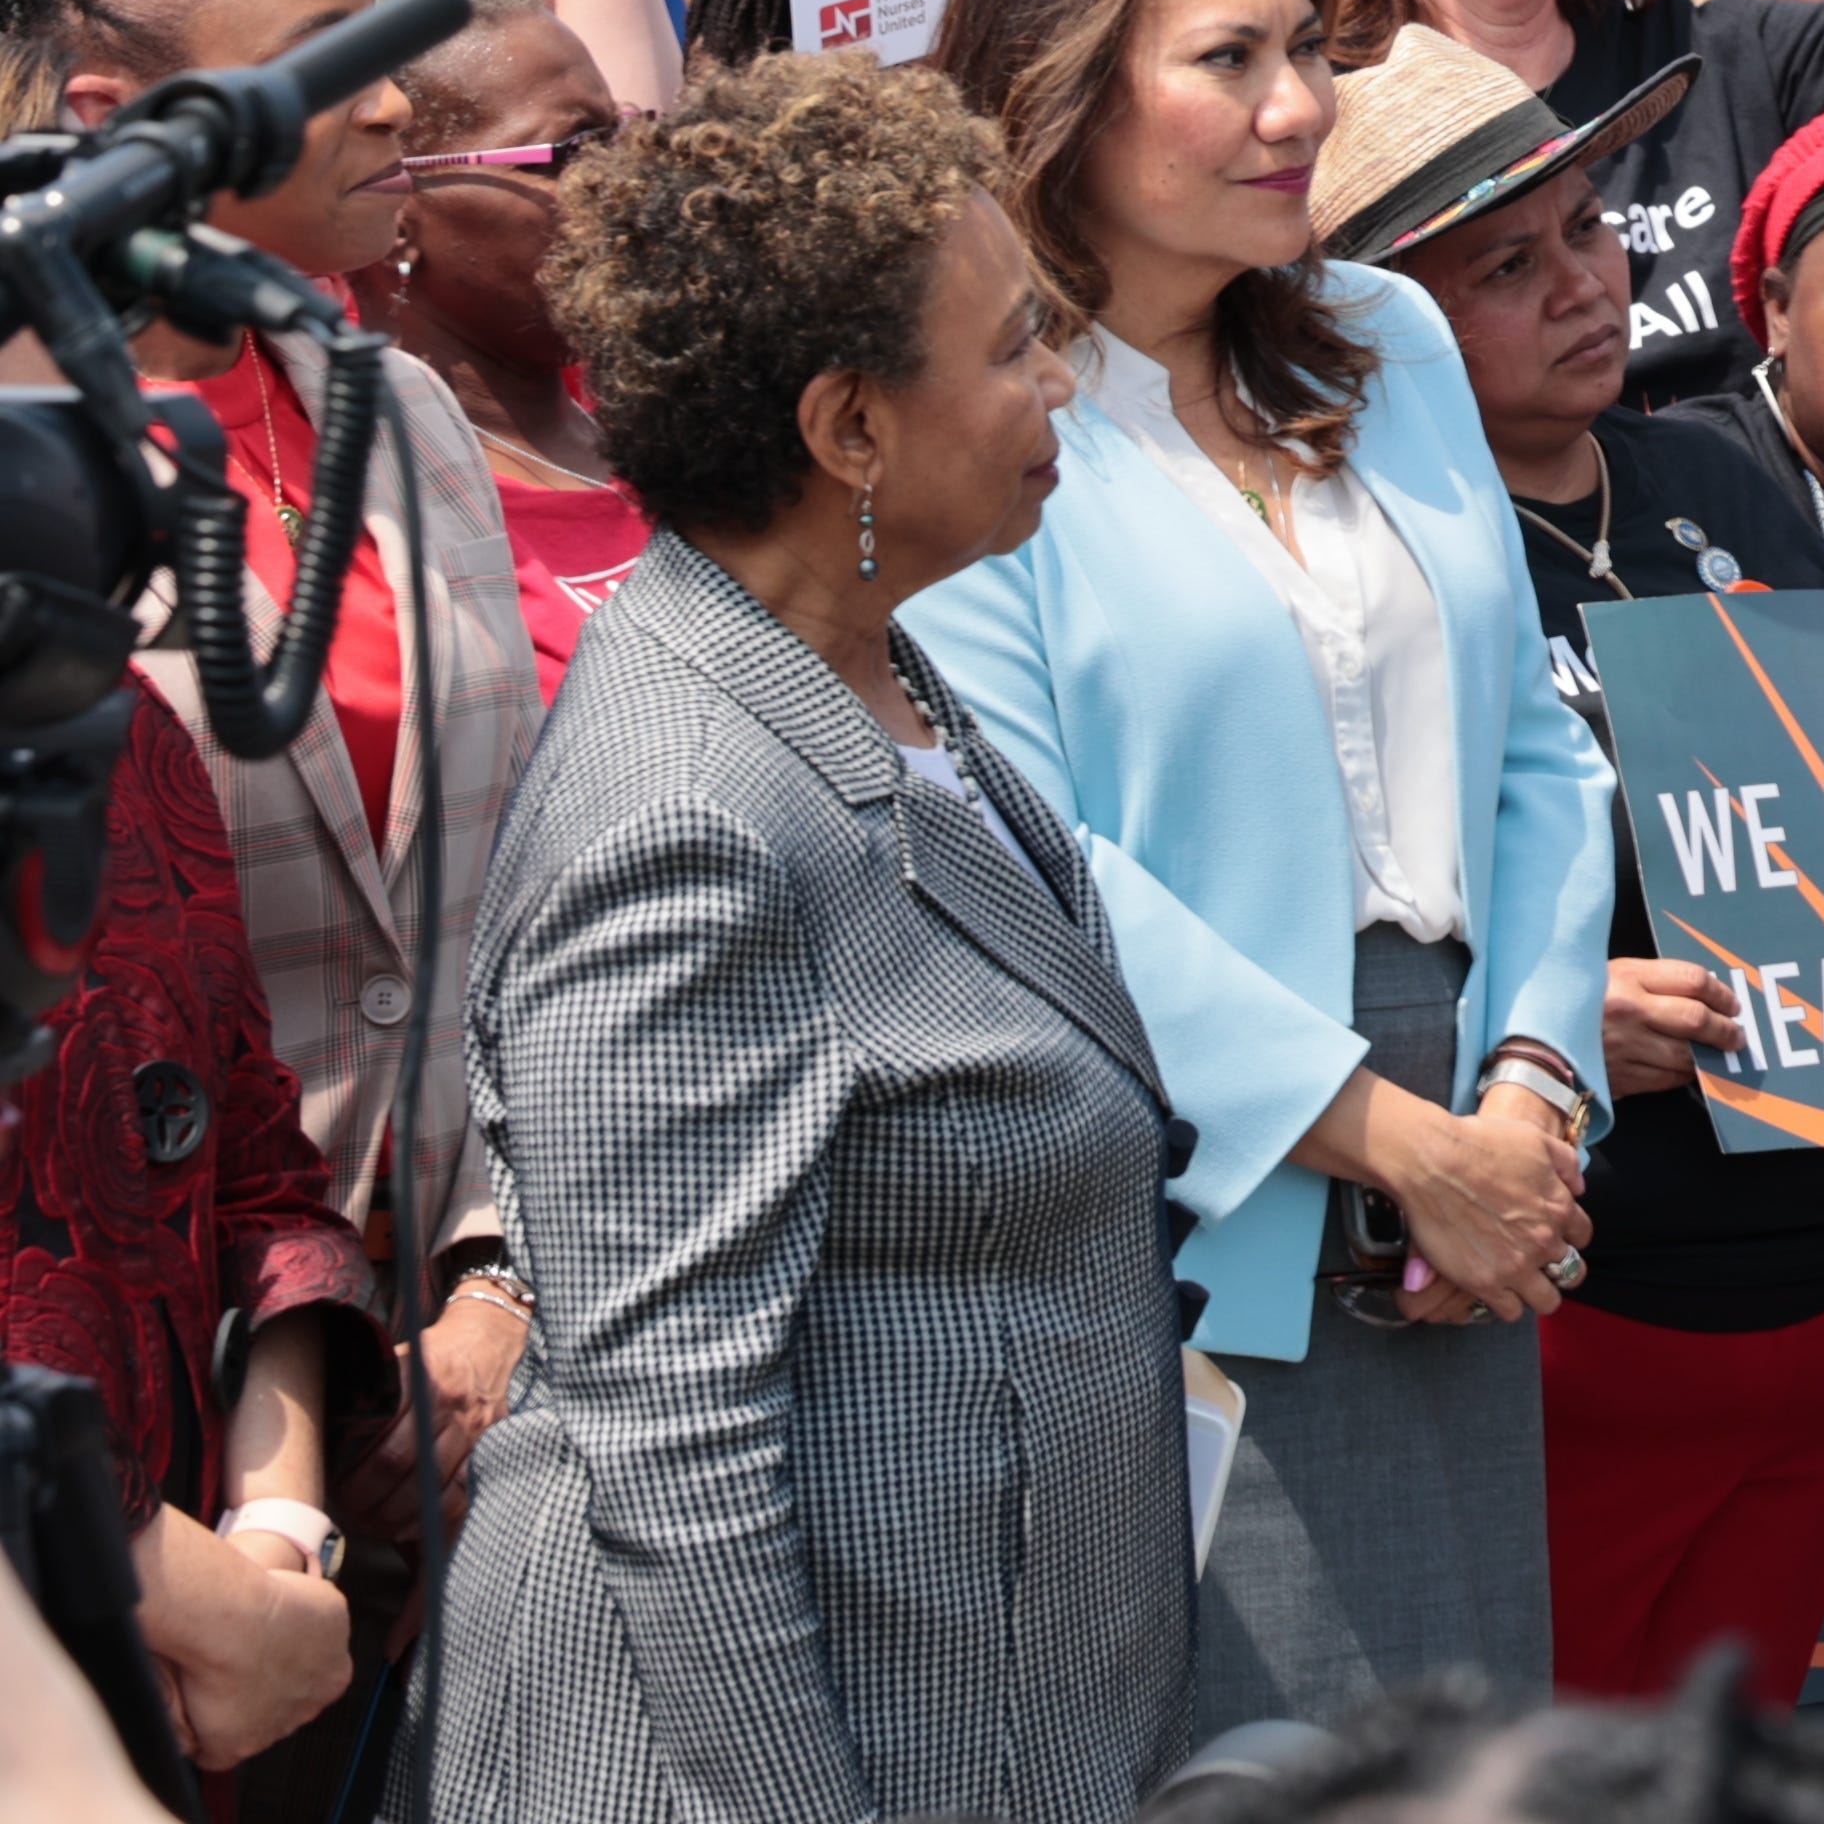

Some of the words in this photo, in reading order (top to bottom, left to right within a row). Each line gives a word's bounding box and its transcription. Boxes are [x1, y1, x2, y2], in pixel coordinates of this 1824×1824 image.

[878, 11, 926, 36] United
[1629, 270, 1718, 350] All
[1658, 782, 1798, 896] WE
